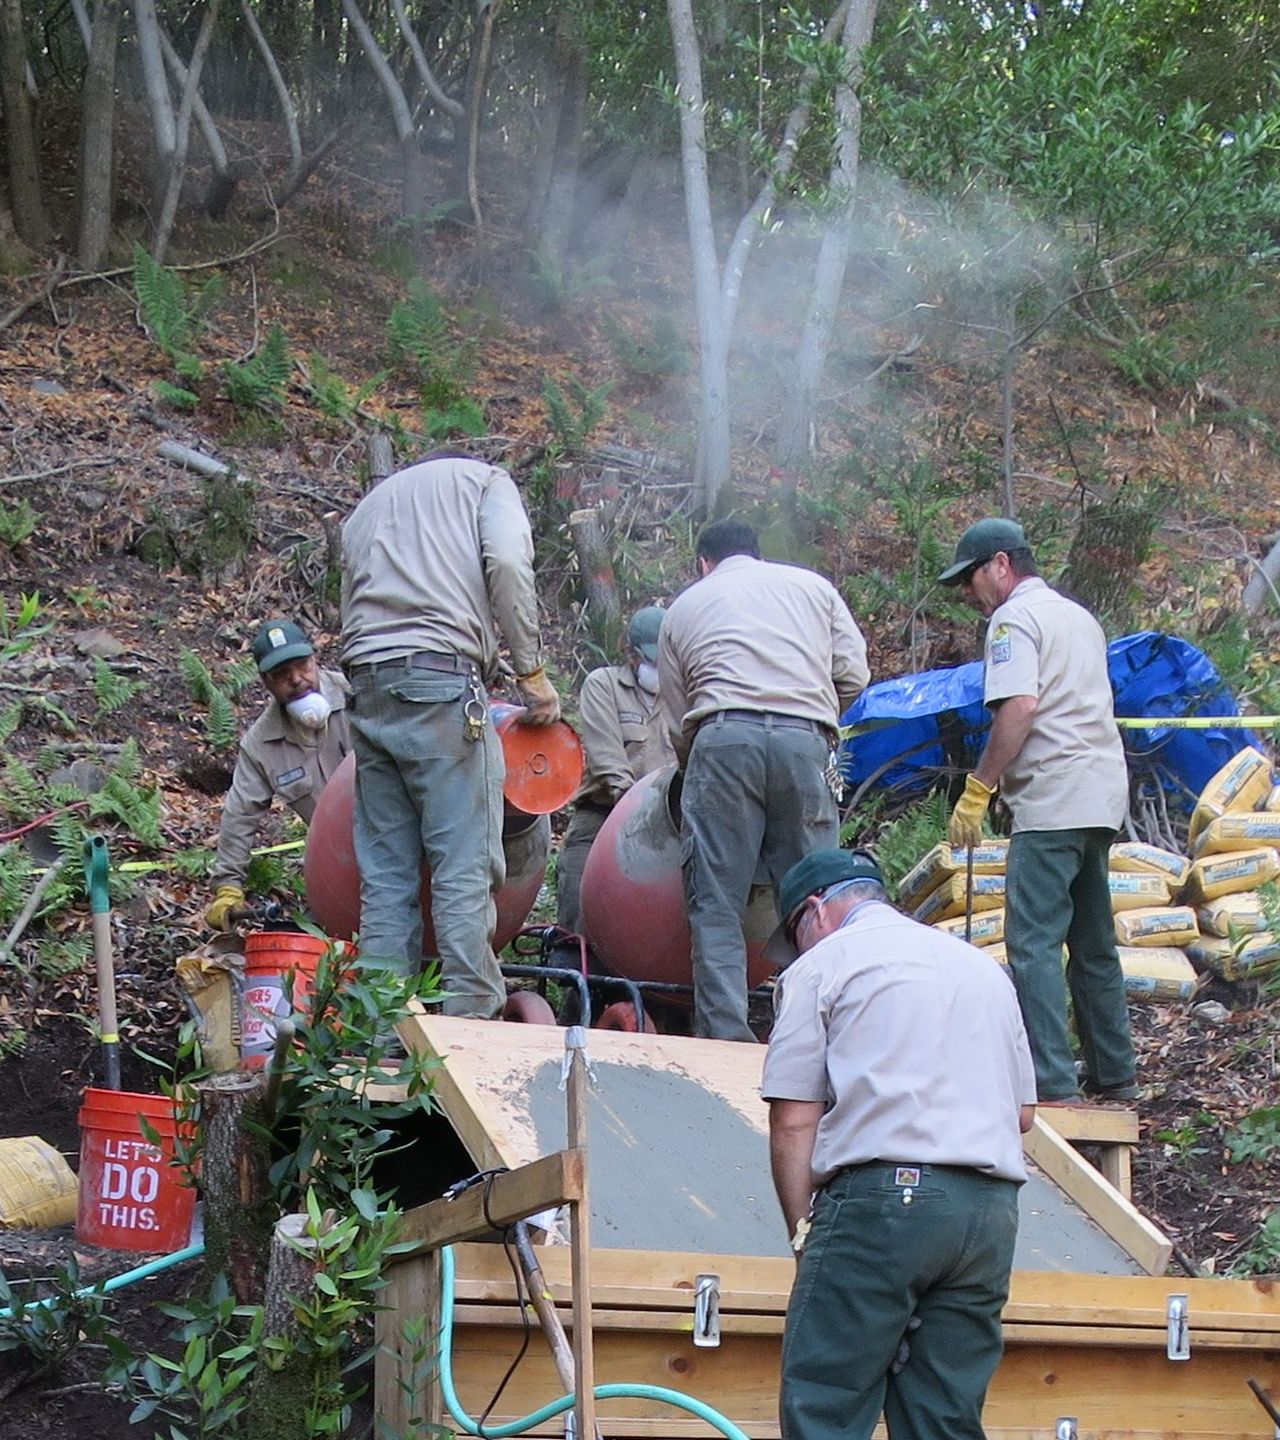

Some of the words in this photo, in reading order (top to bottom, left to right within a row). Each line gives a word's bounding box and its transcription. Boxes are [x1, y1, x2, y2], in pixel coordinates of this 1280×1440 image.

[104, 1138, 162, 1163] LET'S
[101, 1161, 160, 1203] DO
[99, 1202, 160, 1231] THIS.
